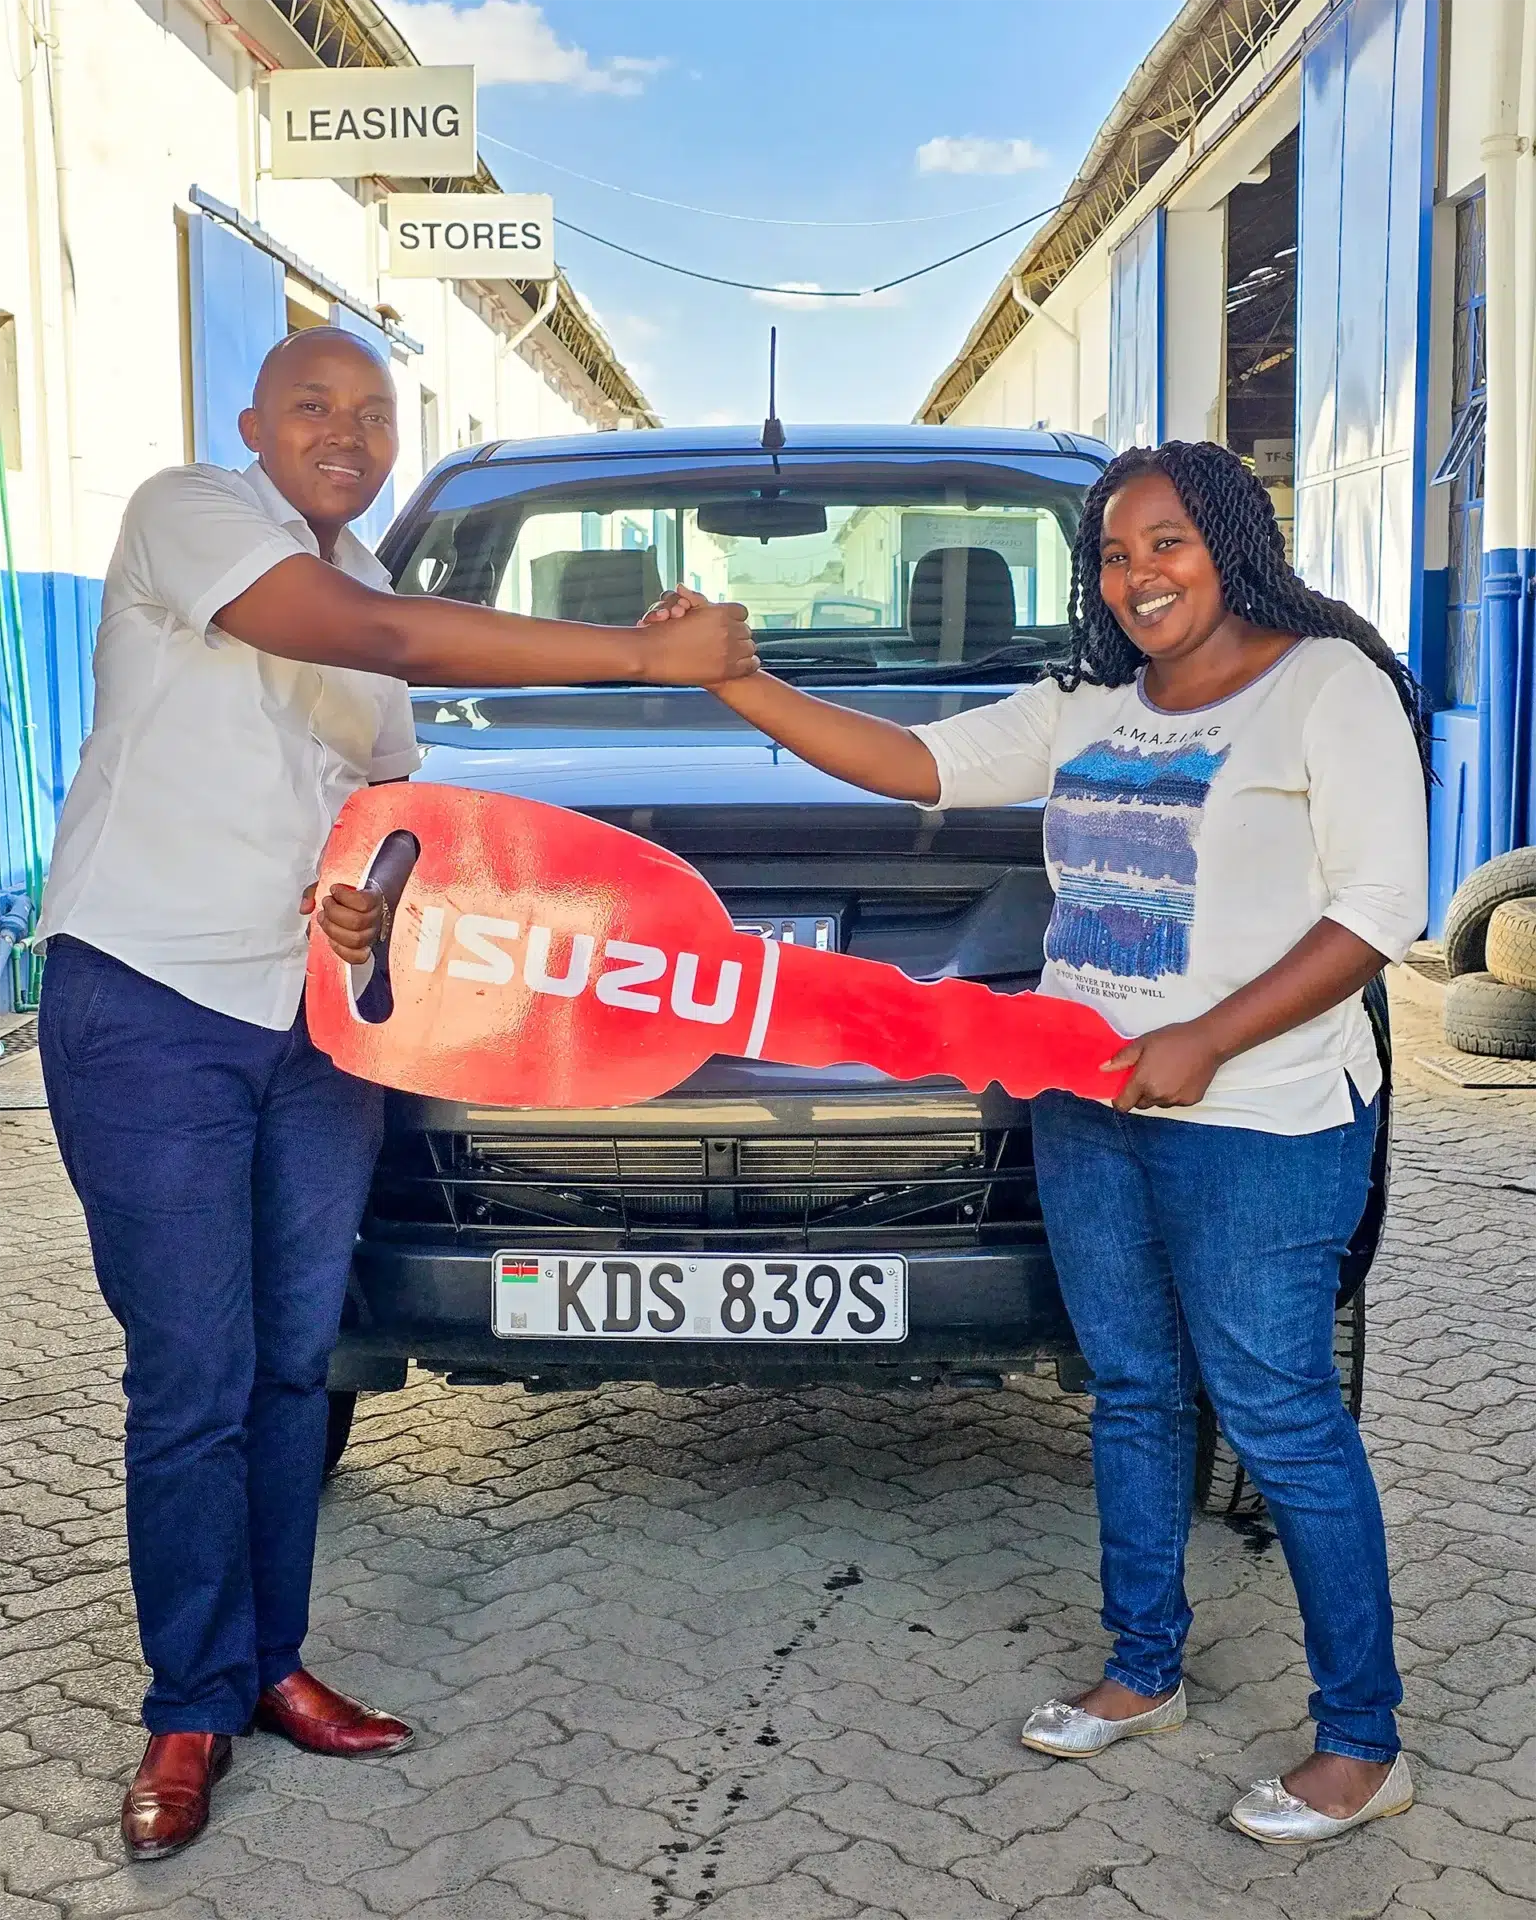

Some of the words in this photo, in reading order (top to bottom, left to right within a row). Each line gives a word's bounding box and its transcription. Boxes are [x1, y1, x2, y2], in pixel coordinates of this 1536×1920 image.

[286, 104, 460, 142] LEASING
[399, 222, 542, 250] STORES
[414, 906, 742, 1025] ISUZU
[1074, 974, 1099, 987] NEVER
[1100, 980, 1116, 990] TRY
[1118, 983, 1138, 994] YOU
[1139, 987, 1166, 998] WILL
[1075, 982, 1101, 995] NEVER
[1102, 989, 1128, 1001] KNOW
[558, 1260, 686, 1334] KDS
[720, 1263, 886, 1335] 839S
